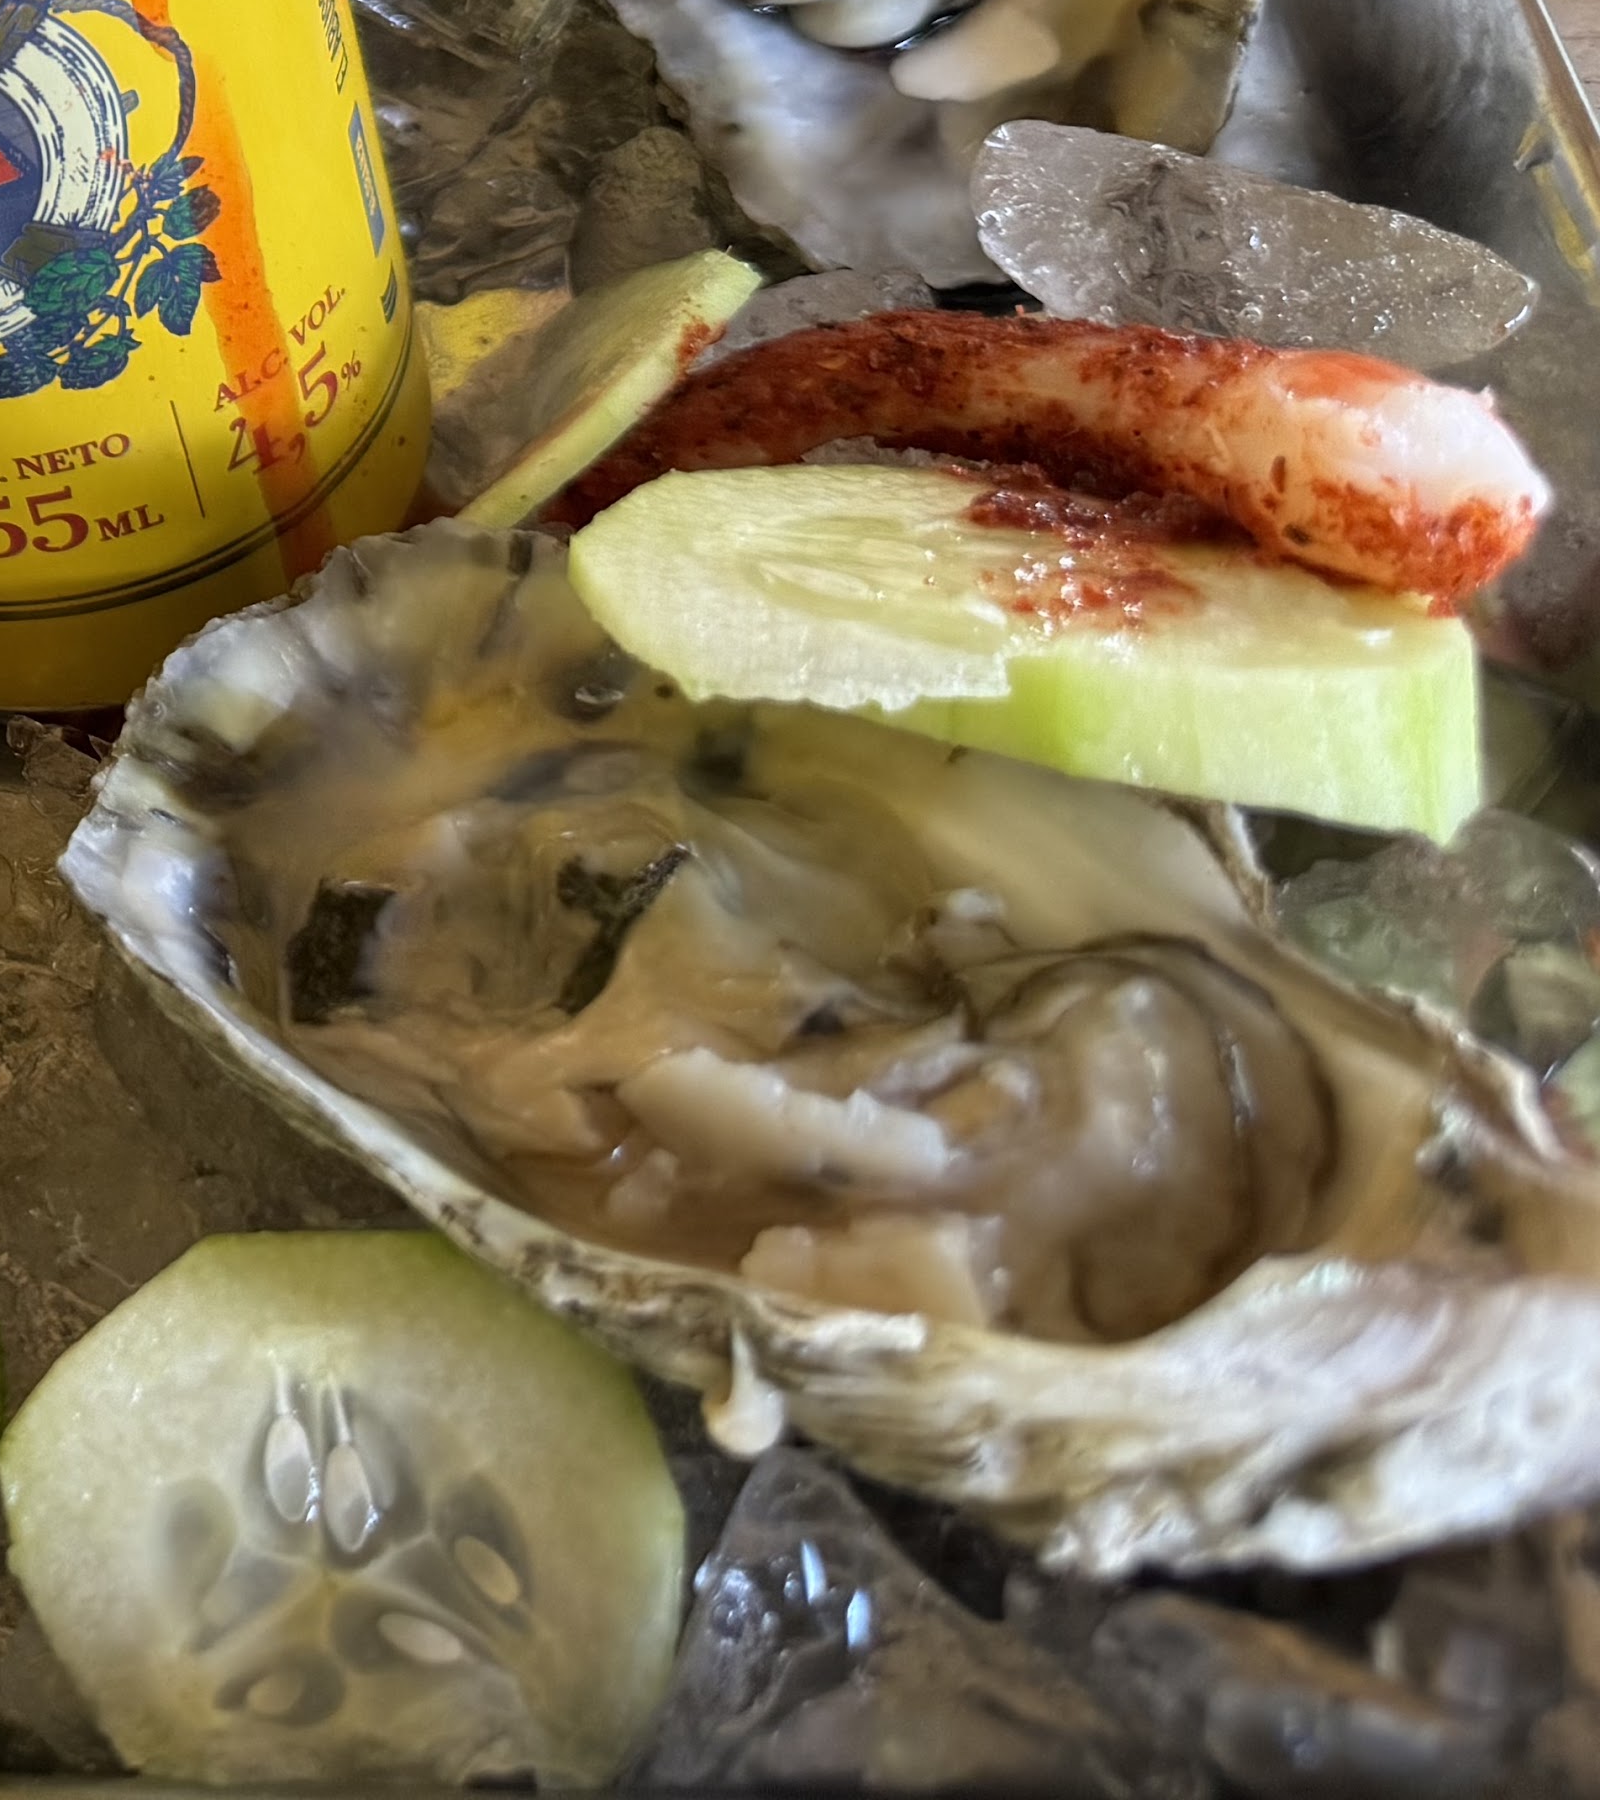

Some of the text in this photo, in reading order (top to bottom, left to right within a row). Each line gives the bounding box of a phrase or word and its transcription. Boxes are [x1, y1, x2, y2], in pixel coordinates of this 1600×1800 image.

[213, 283, 347, 411] ALC. VOL.
[16, 431, 131, 481] NETO
